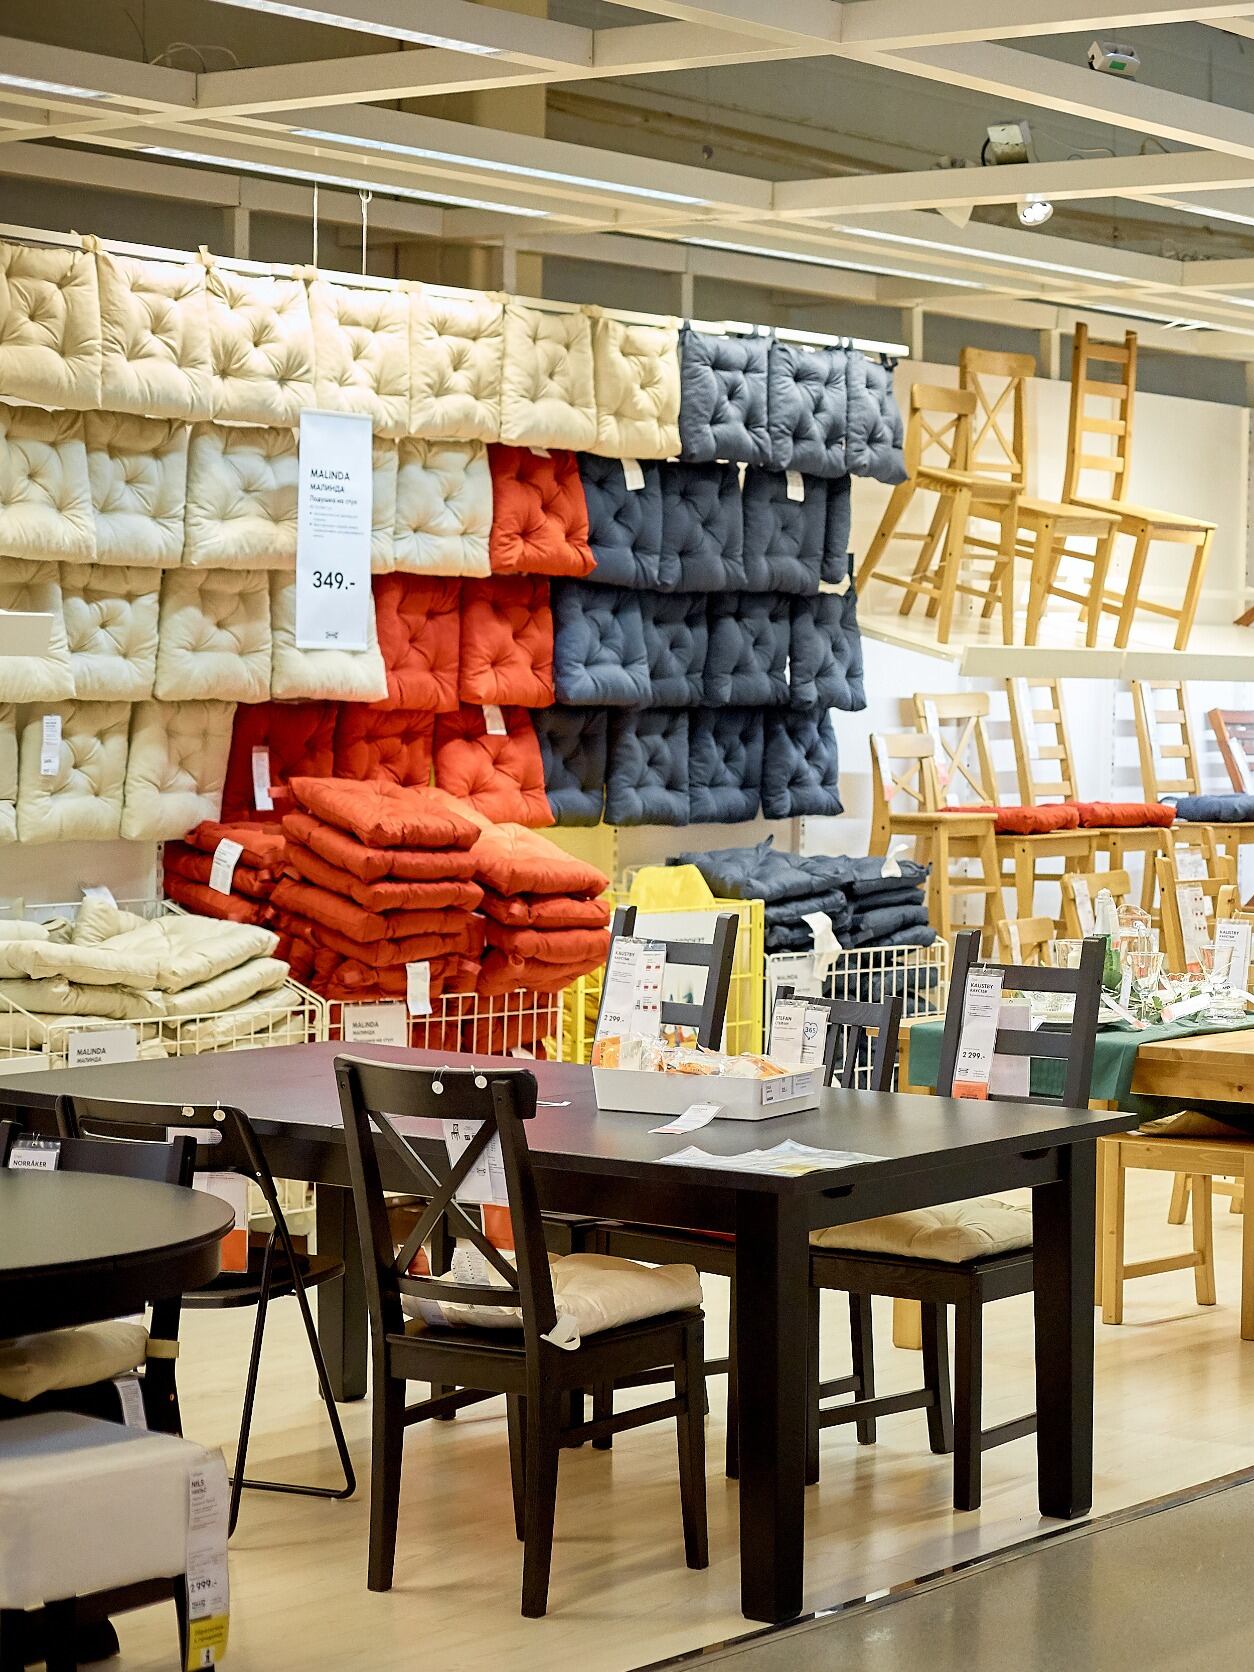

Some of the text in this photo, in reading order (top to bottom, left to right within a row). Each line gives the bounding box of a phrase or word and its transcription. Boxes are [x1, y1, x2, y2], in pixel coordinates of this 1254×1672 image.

[311, 469, 351, 480] MALINDA
[312, 570, 355, 590] 349.-
[970, 982, 994, 990] KAUSTBY
[77, 1047, 107, 1056] MALINDA
[13, 1160, 47, 1168] NORRÅKER
[191, 1479, 205, 1488] NILS
